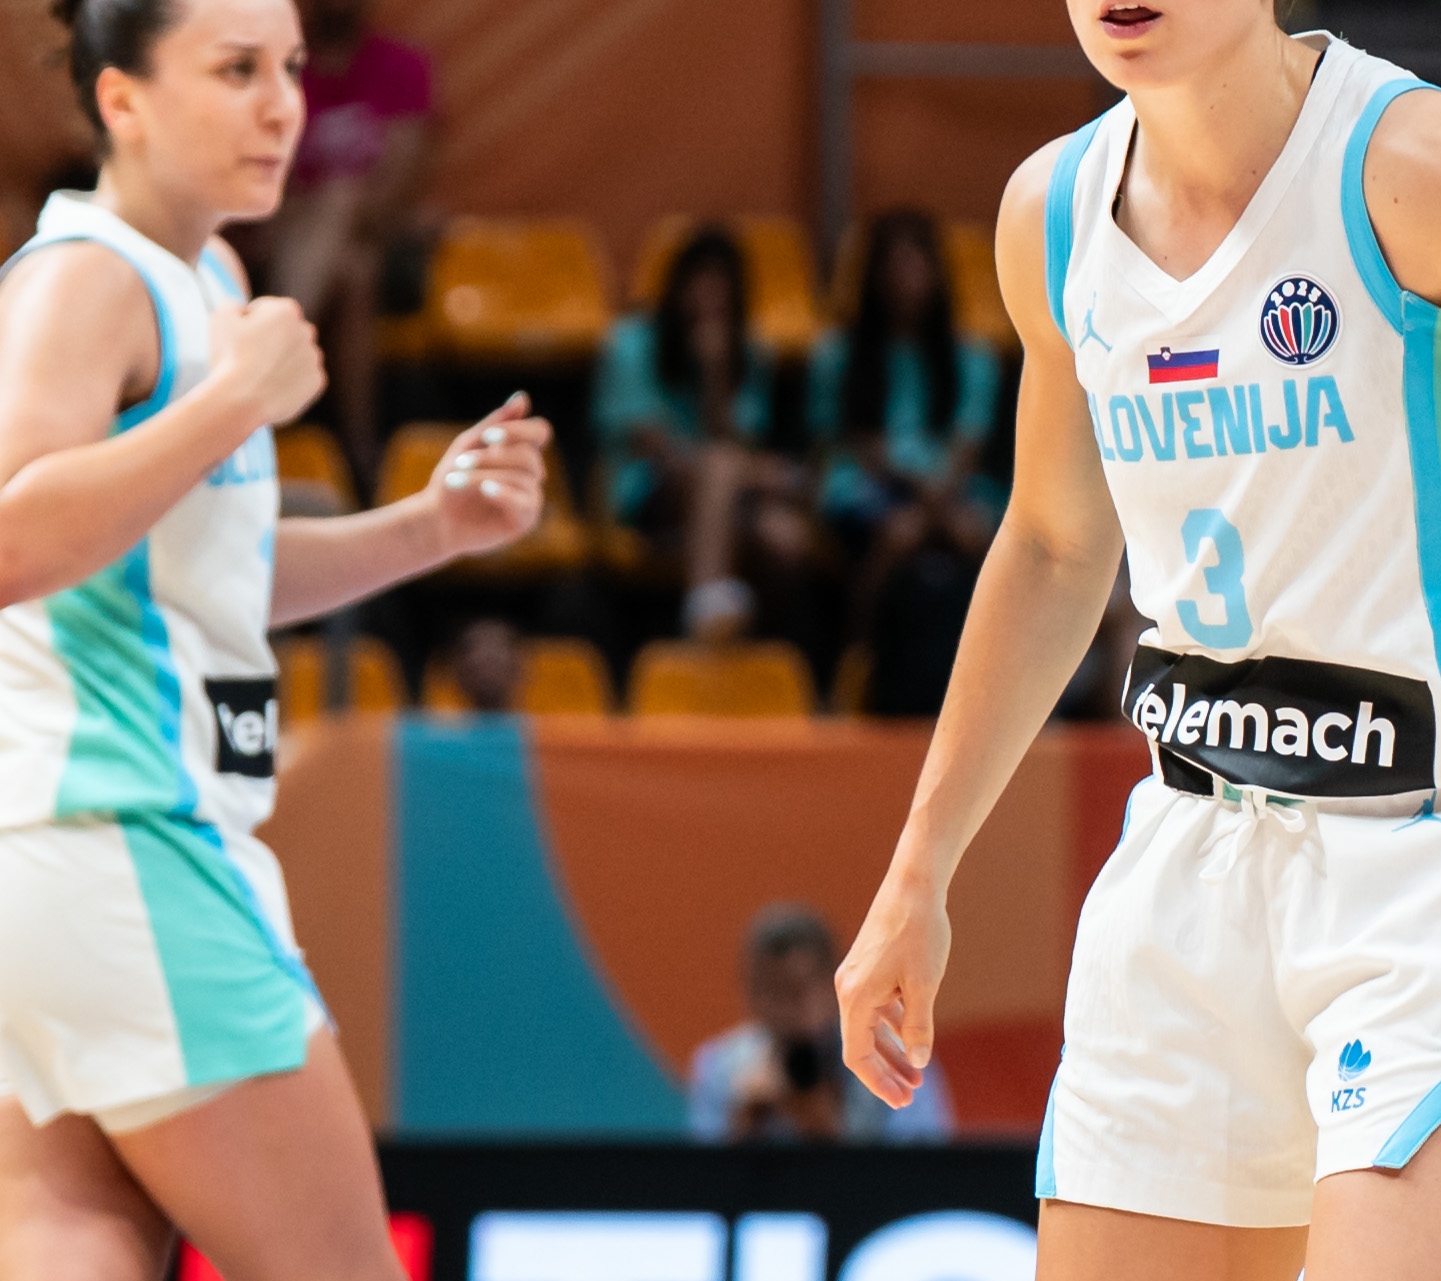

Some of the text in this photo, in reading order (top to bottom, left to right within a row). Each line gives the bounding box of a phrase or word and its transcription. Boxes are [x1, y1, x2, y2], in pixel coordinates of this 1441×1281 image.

[1270, 280, 1322, 308] 2025
[1086, 375, 1356, 462] LOVENIJA
[1176, 509, 1254, 649] 3
[1331, 1087, 1368, 1113] KZS
